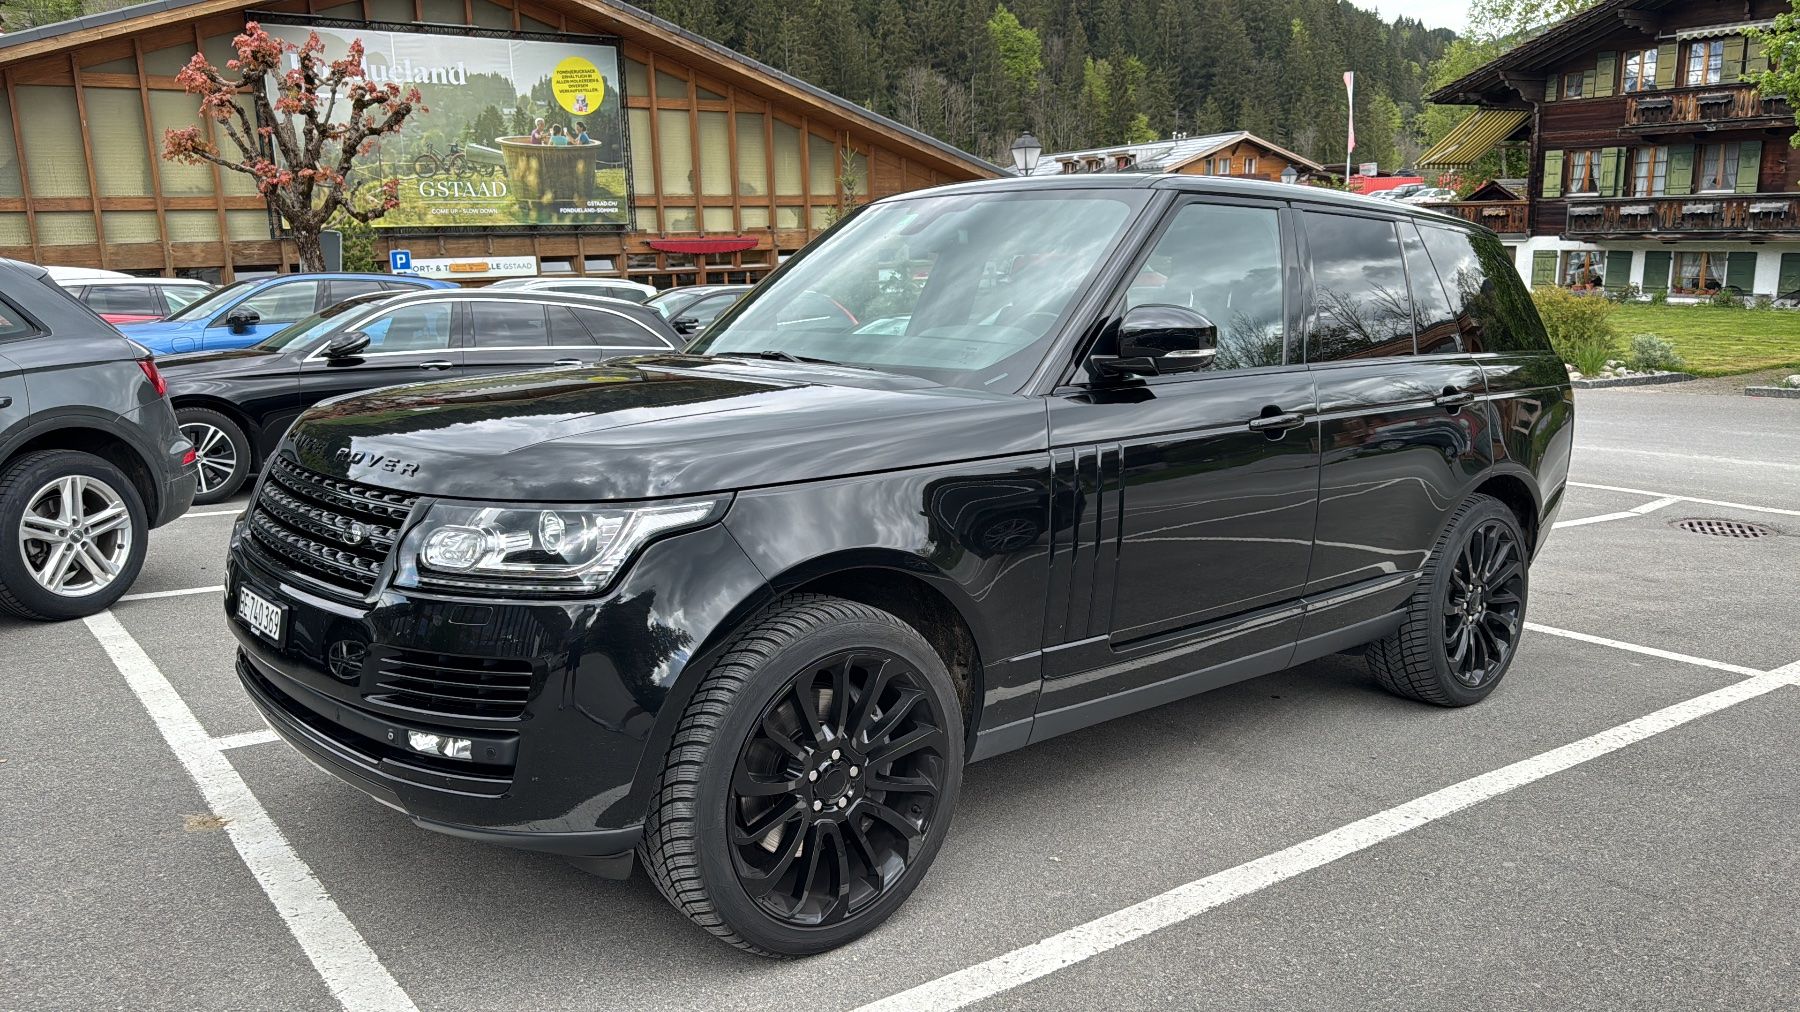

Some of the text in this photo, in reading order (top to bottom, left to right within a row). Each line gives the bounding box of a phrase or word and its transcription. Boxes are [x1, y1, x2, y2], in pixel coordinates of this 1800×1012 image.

[418, 181, 507, 198] GSTAAD
[396, 254, 406, 268] P
[503, 262, 532, 270] GSTAAD
[335, 447, 420, 478] ROVER
